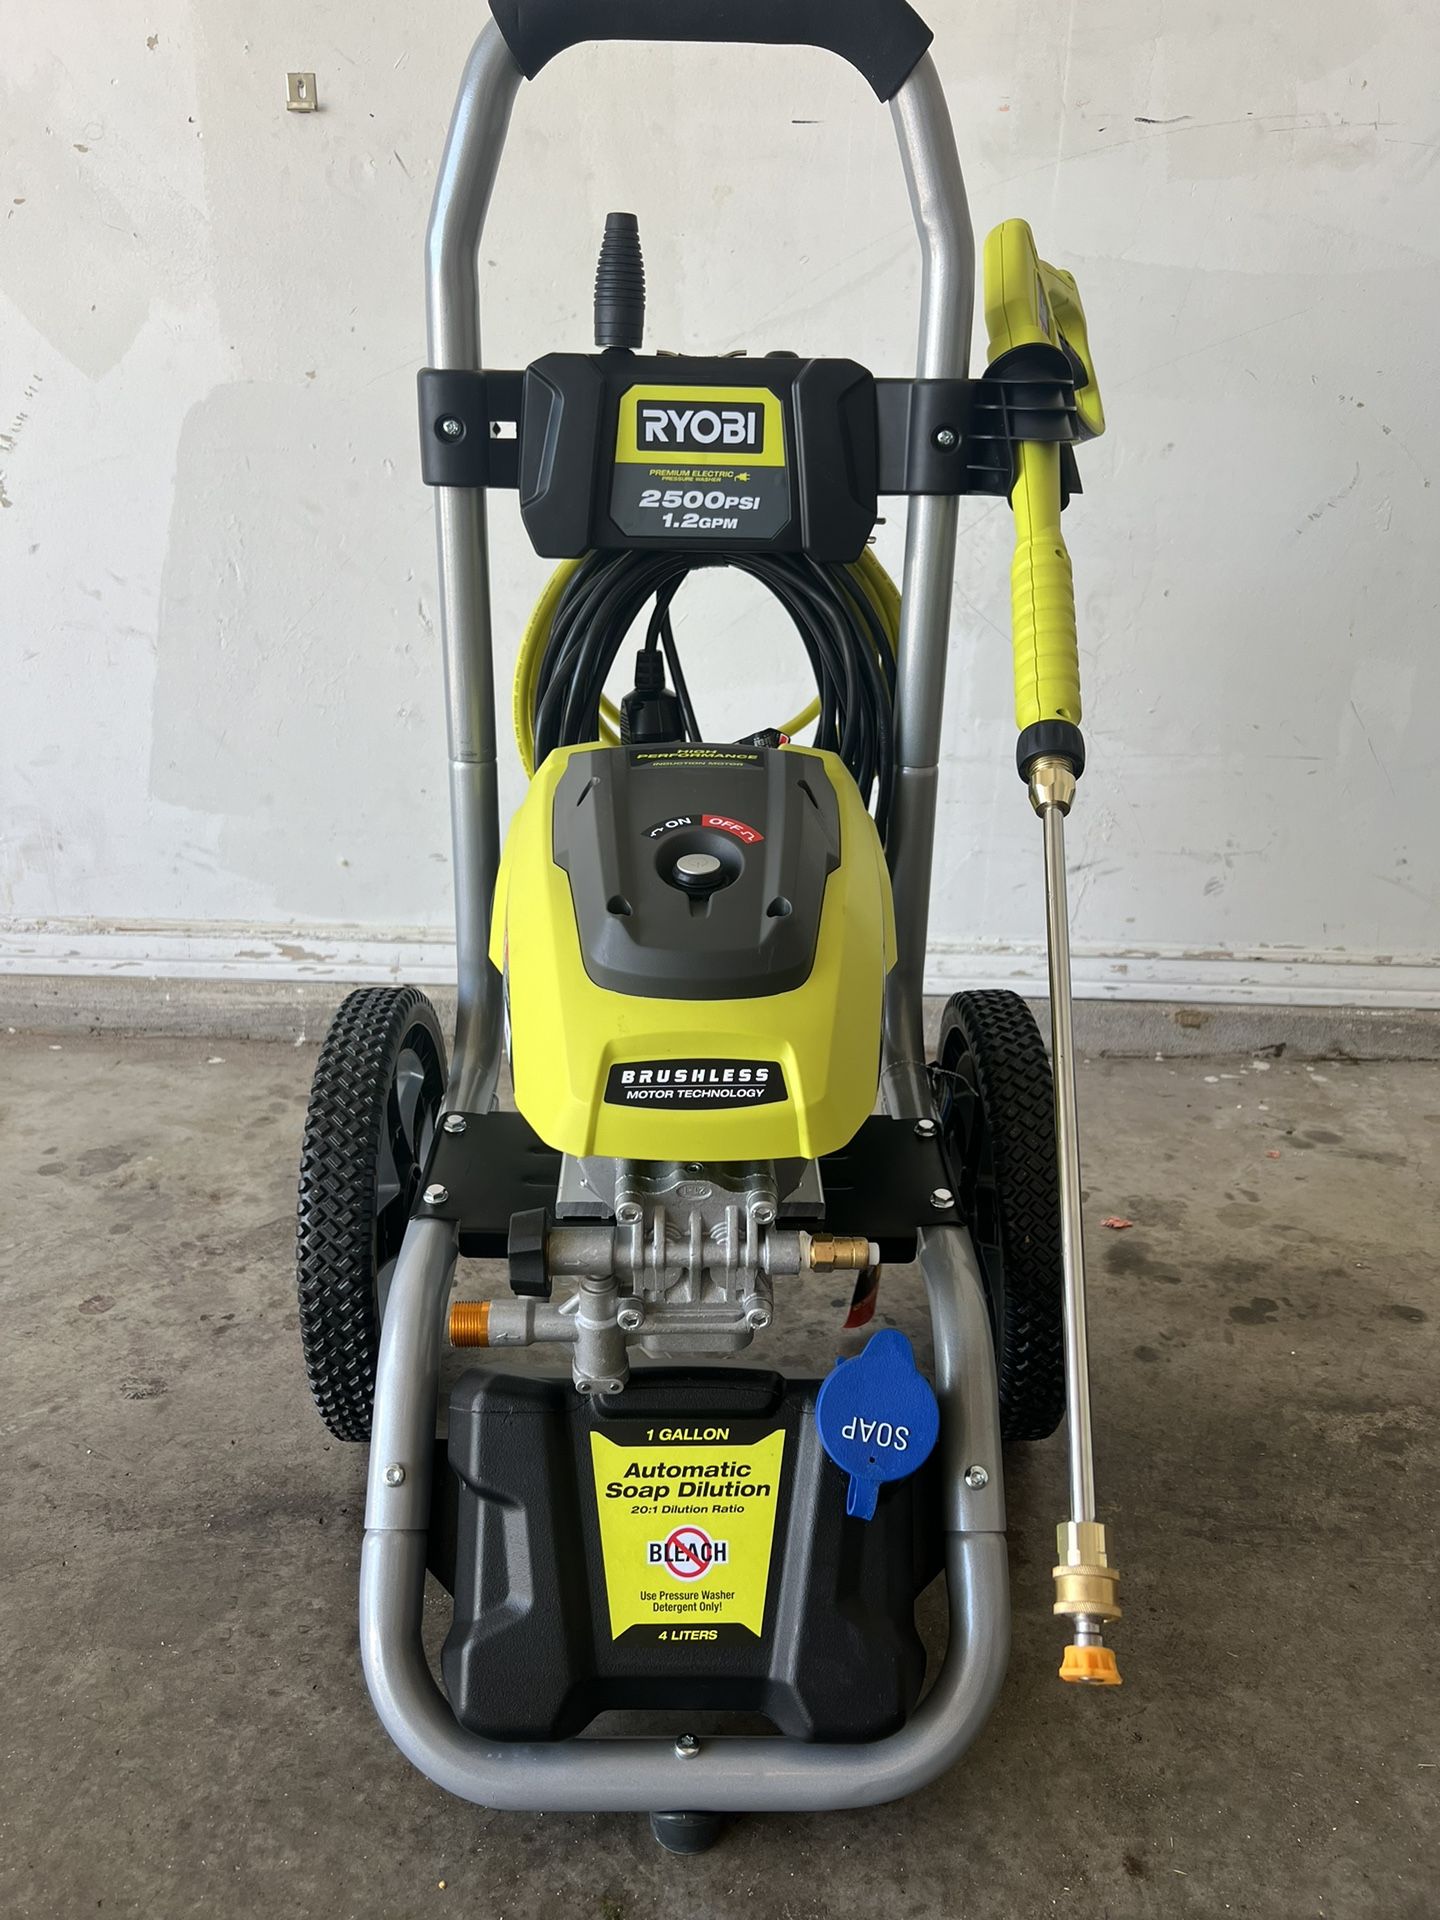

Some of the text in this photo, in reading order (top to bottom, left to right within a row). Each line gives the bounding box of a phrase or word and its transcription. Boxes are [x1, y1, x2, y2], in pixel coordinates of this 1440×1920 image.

[642, 409, 756, 444] RYOBI
[649, 469, 734, 478] PREMIUM ELECTRIC
[639, 490, 760, 510] 2500PSI
[662, 513, 738, 529] 1.2GPM
[637, 752, 758, 760] PERFORMANCE
[665, 817, 742, 831] ON OFF
[621, 1068, 769, 1084] BRUSHLESS
[626, 1088, 764, 1100] MOTOR TECHNOLOGY
[646, 1428, 729, 1441] 1 GALLON
[841, 1416, 910, 1451] SOAP
[624, 1462, 752, 1479] Automatic
[605, 1481, 771, 1501] Soap Dilution
[631, 1505, 744, 1514] 20:1 Dilution Ratio
[649, 1542, 727, 1562] BLEACH
[640, 1590, 735, 1601] Use Pressure Washer
[653, 1602, 722, 1613] Detergent Only!
[658, 1630, 718, 1641] 4 LITERS
